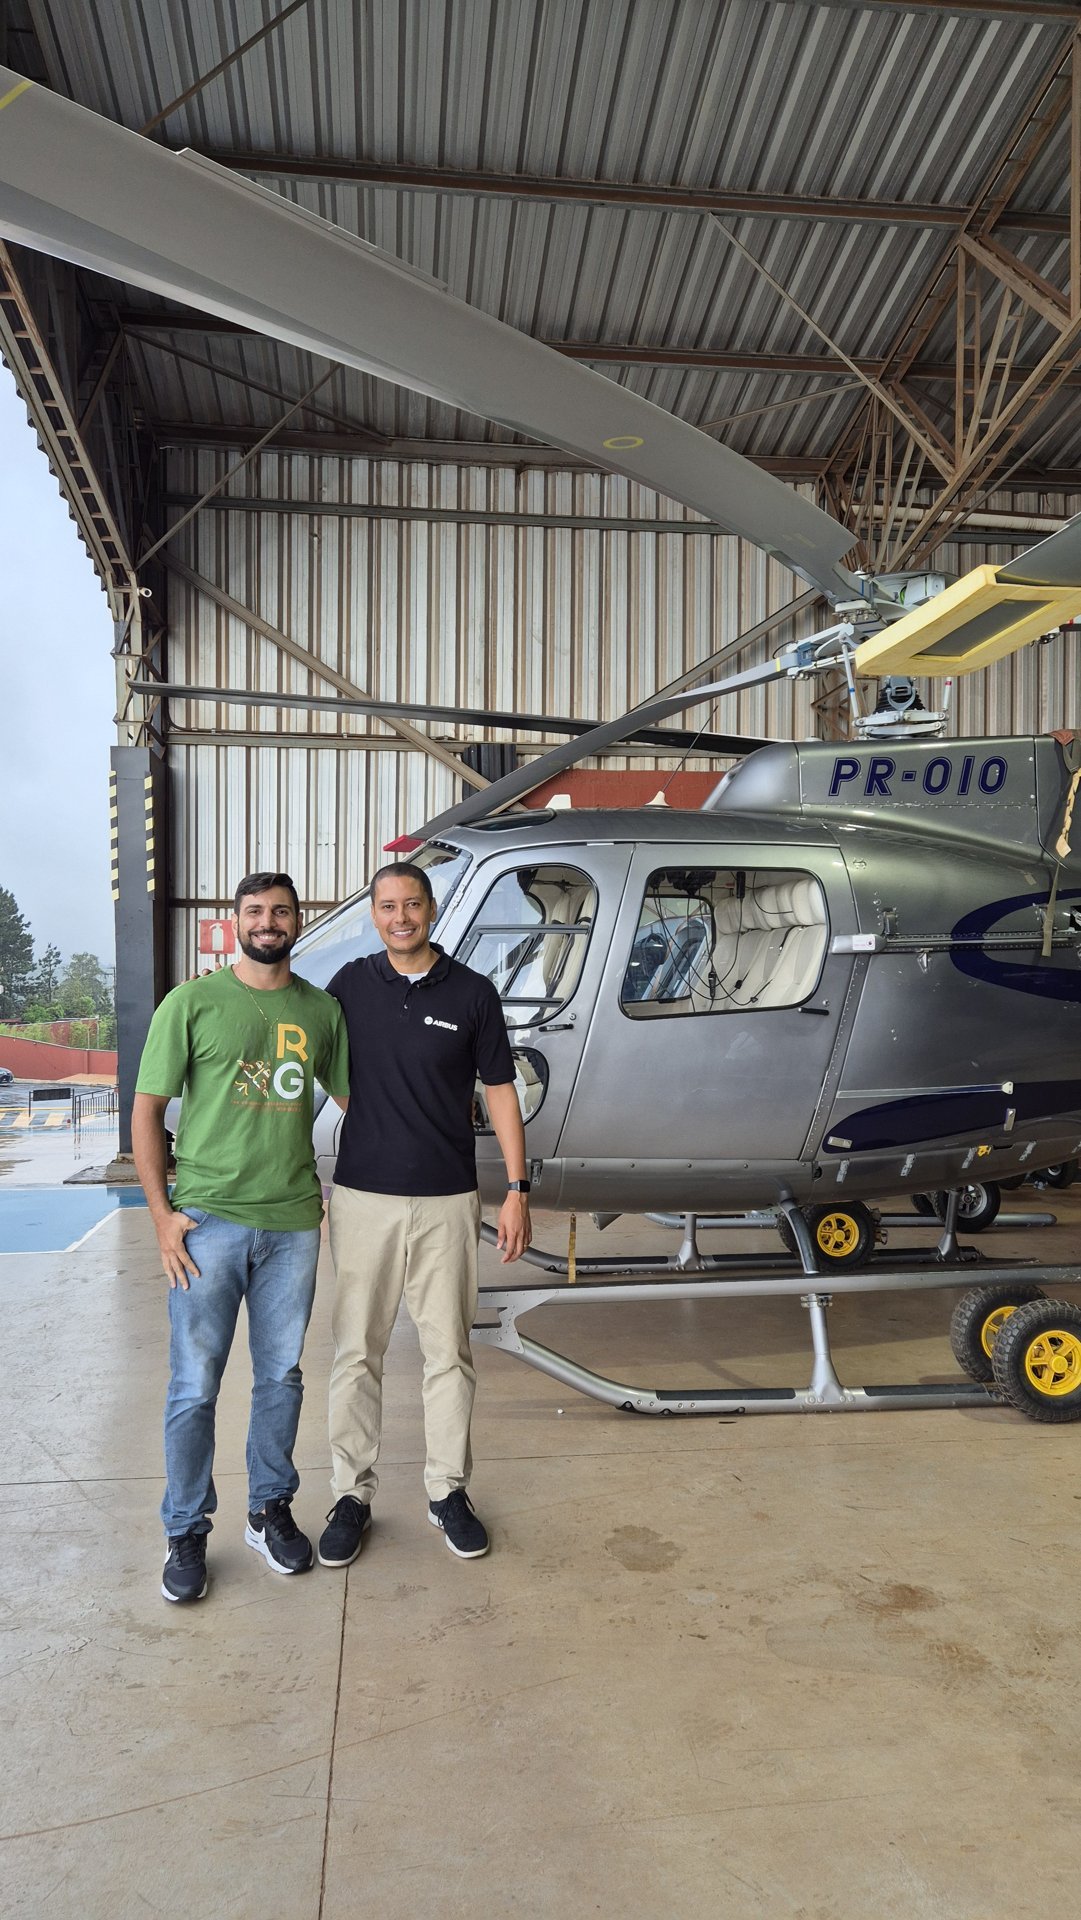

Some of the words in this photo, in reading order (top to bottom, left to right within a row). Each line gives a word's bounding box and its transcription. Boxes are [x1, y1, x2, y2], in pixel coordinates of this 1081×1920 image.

[277, 1023, 309, 1062] R
[433, 1019, 458, 1031] AIRBUS
[273, 1061, 305, 1100] G
